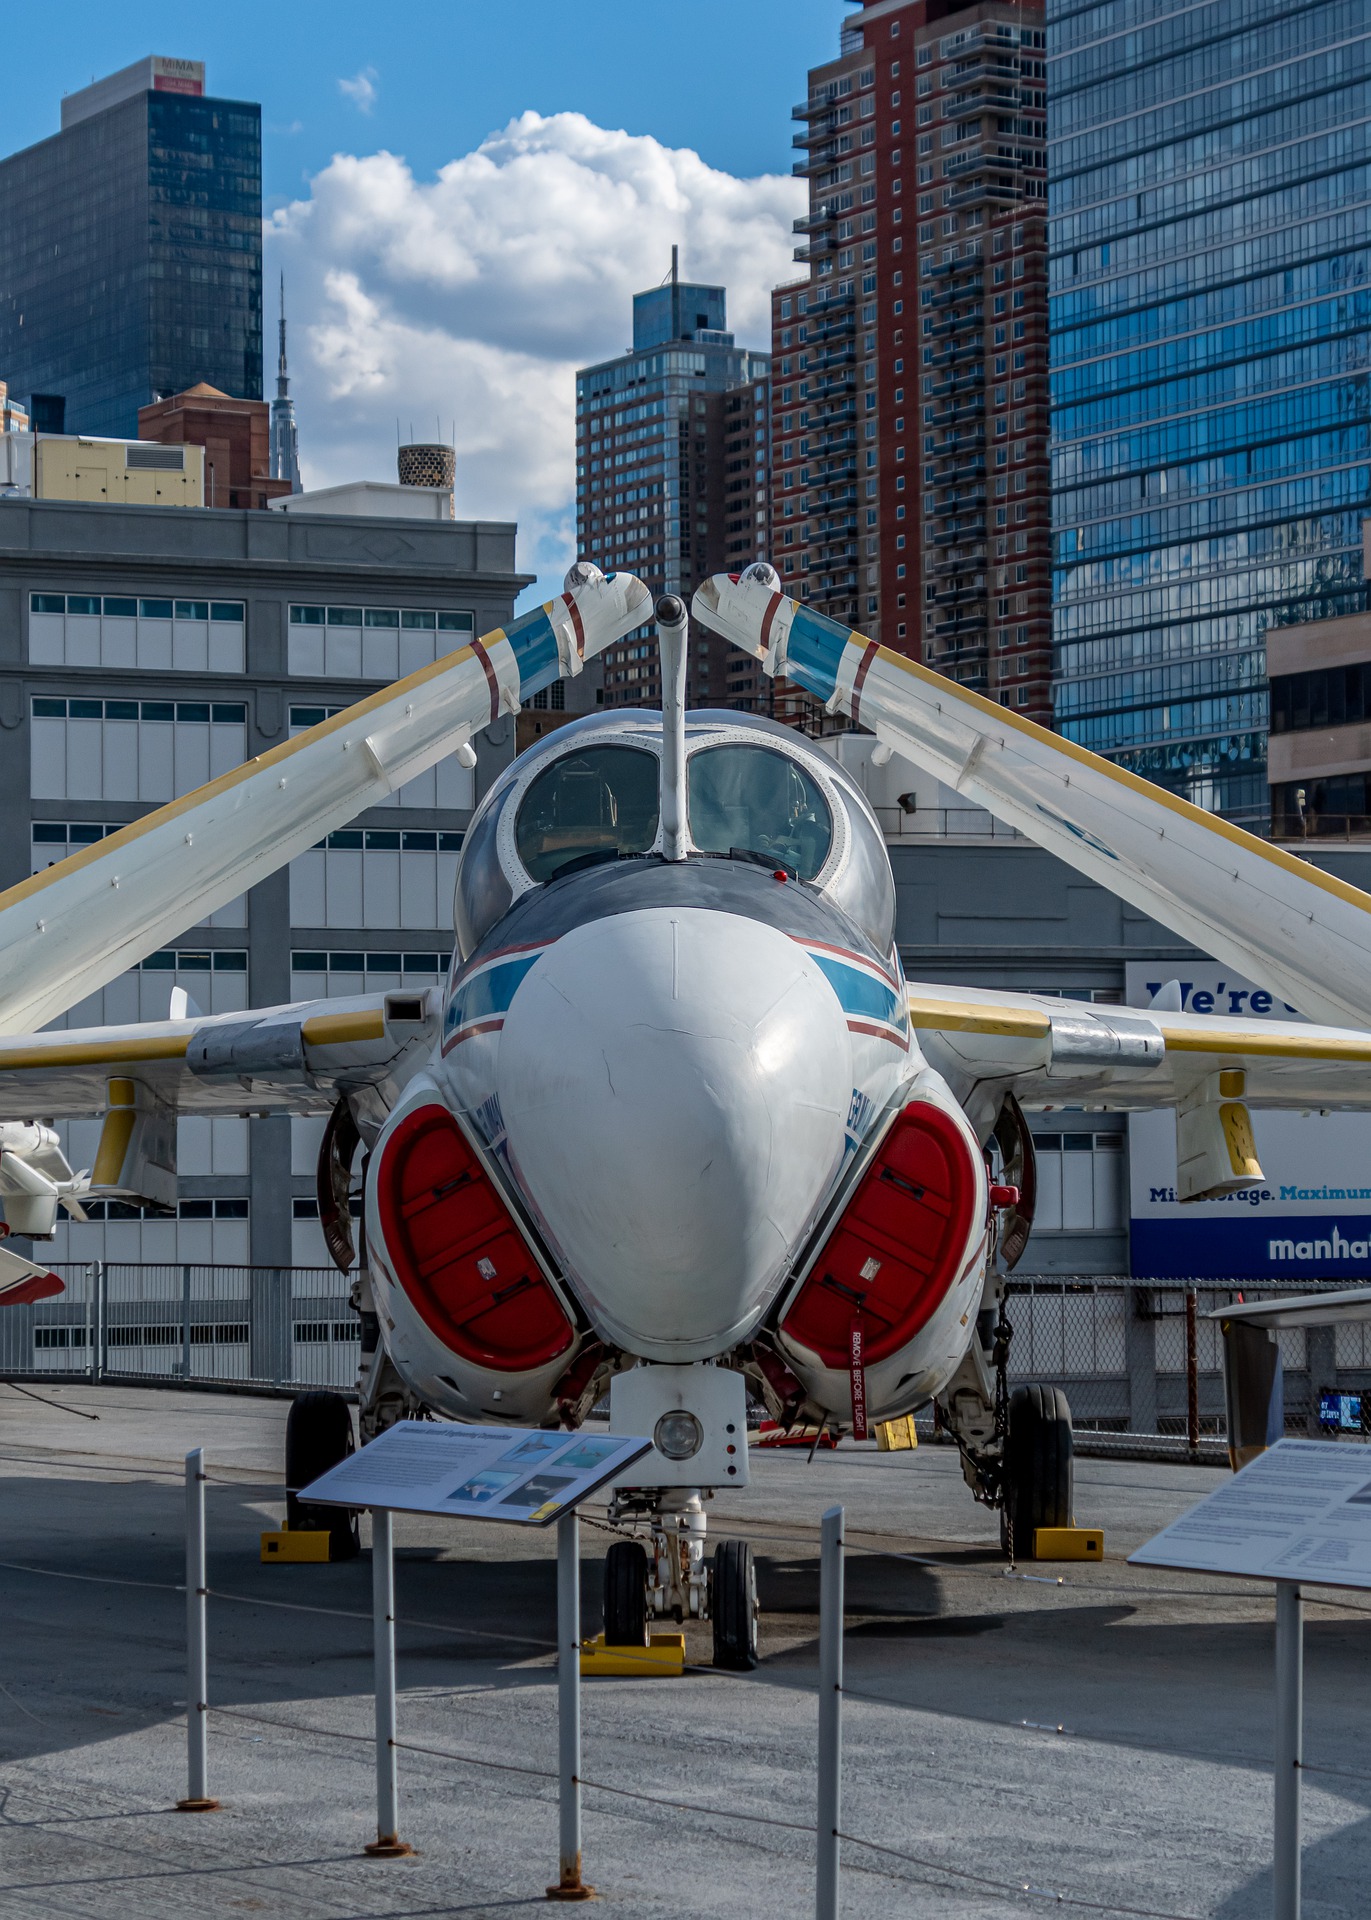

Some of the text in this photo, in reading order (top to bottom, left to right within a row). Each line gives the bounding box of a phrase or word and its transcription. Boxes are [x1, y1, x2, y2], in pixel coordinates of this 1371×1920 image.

[1279, 1185, 1371, 1201] Maximum
[1269, 1224, 1371, 1260] manha
[852, 1331, 864, 1432] REMOVE BEFORE FLIGHT
